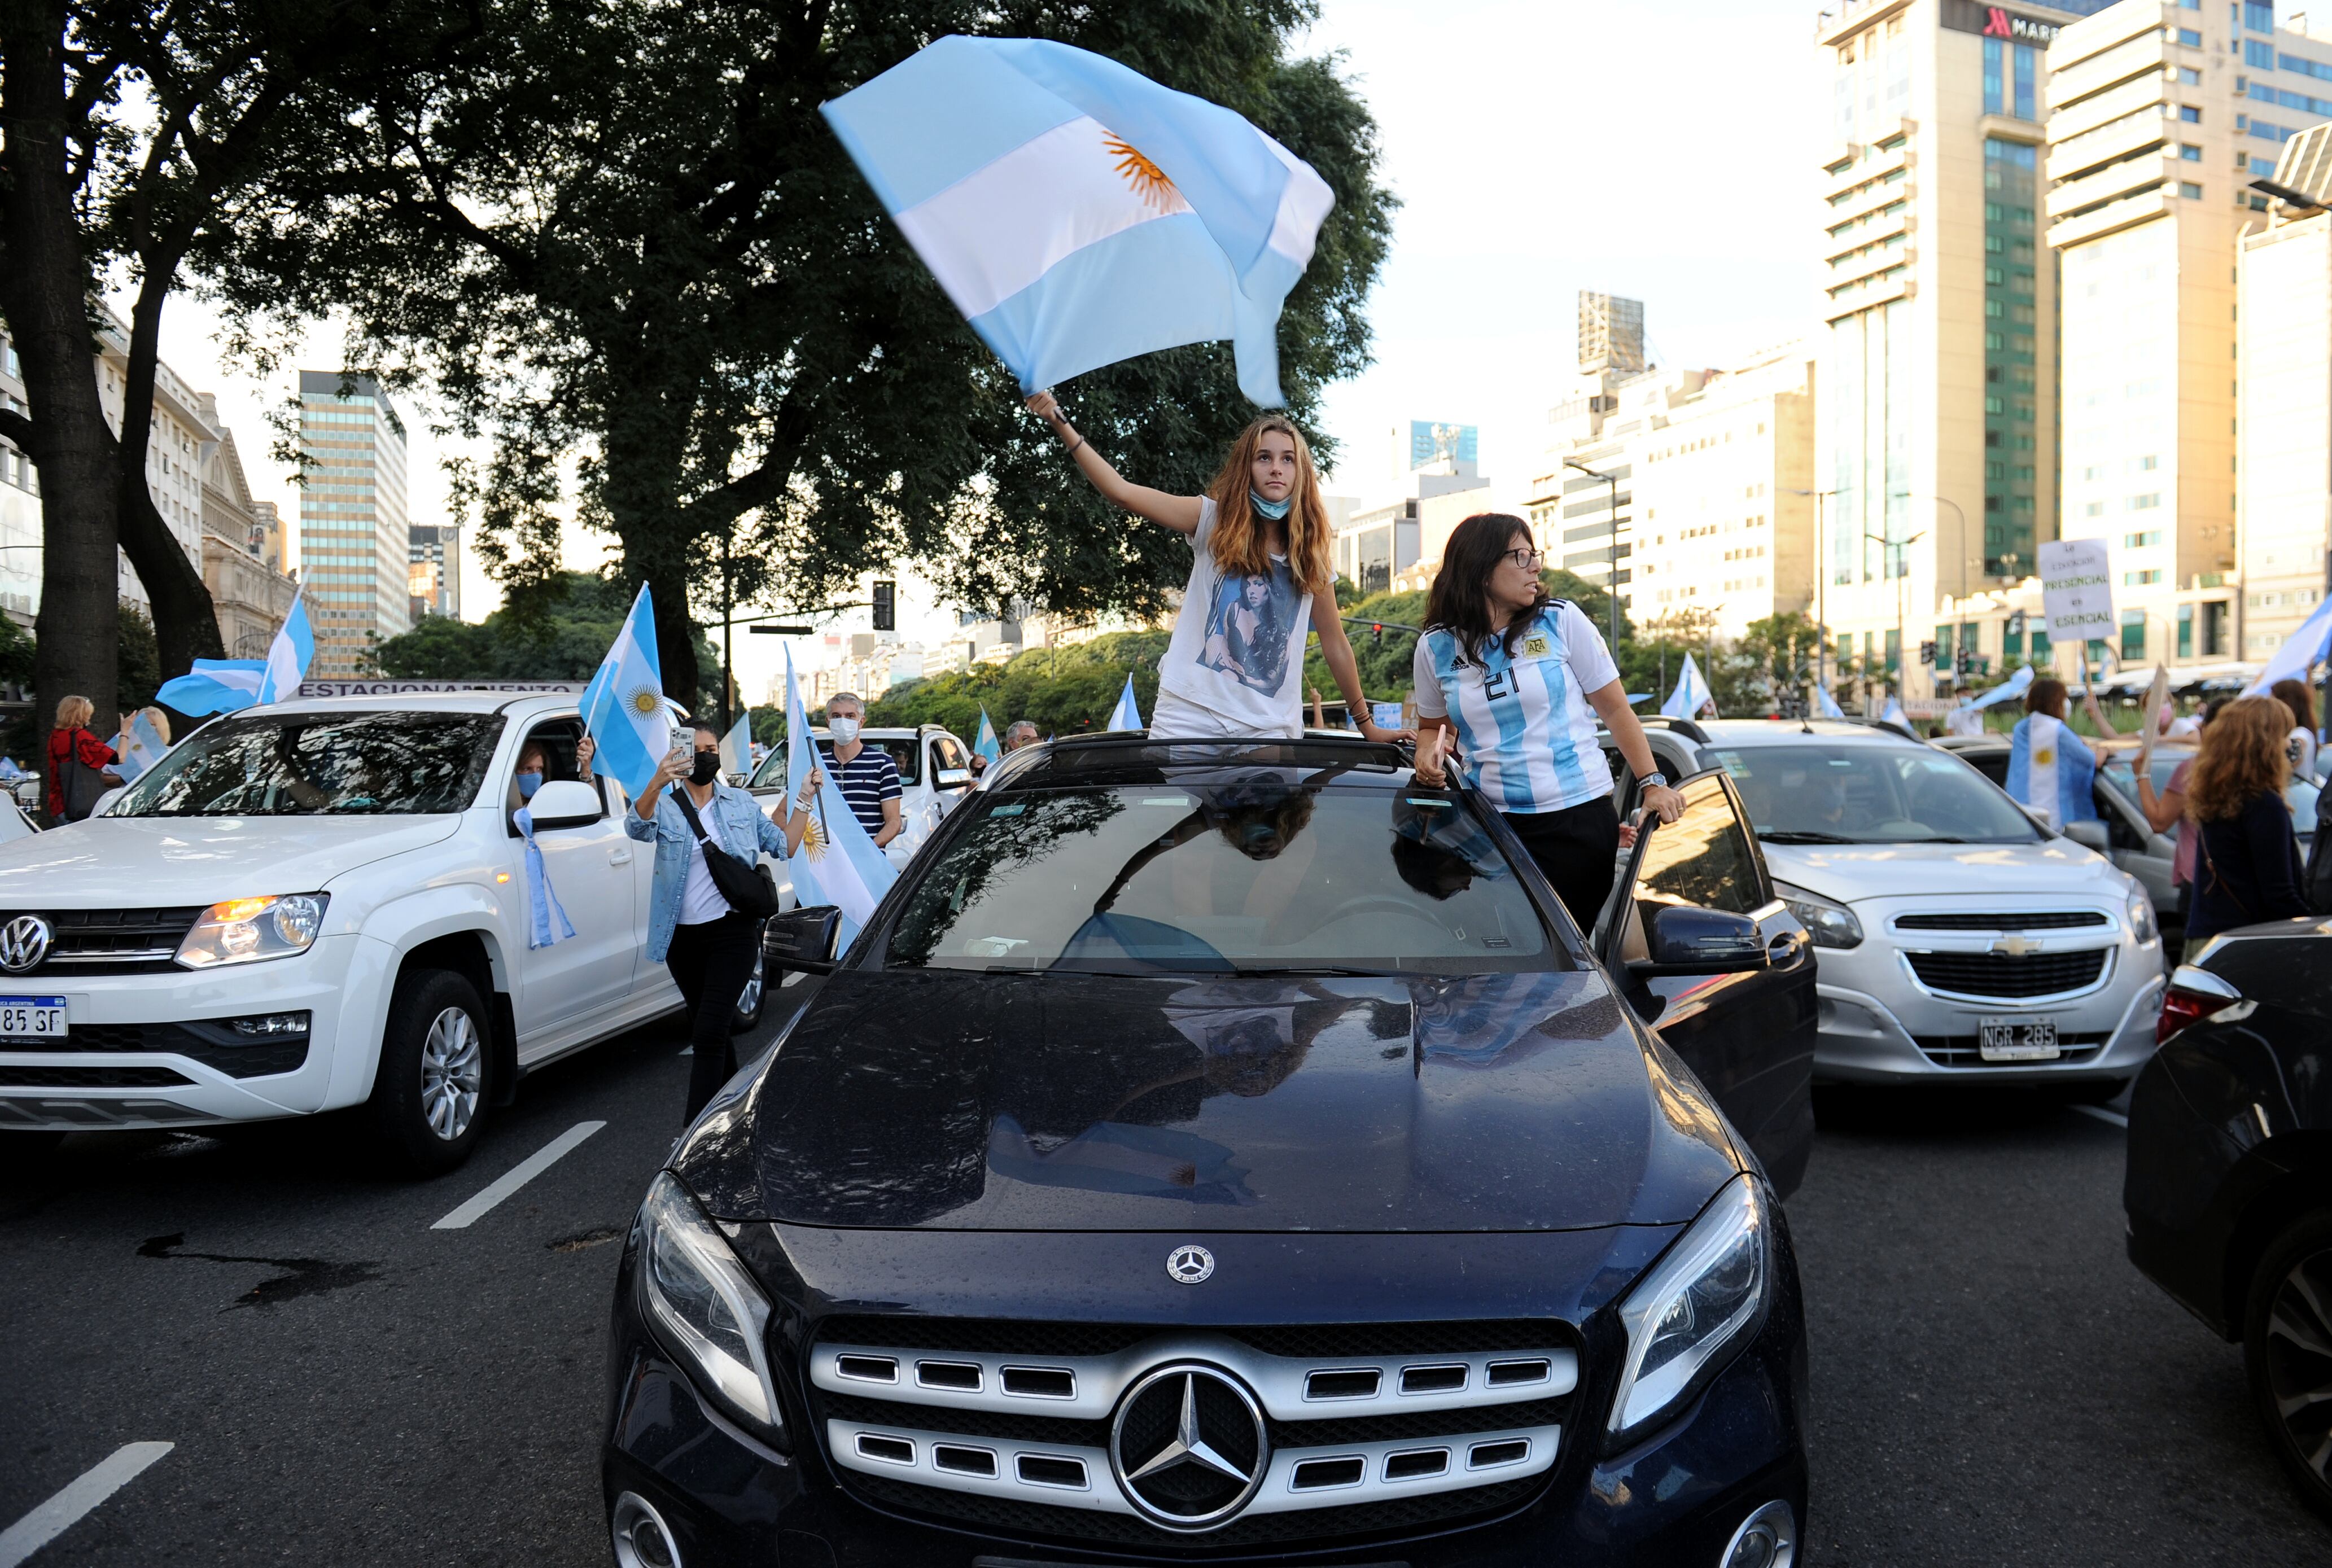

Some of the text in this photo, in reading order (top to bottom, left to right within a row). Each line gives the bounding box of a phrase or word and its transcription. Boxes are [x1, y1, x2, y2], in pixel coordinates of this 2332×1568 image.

[2045, 574, 2109, 590] PRESENCIAL
[2055, 610, 2111, 628] ESENCIAL
[1529, 638, 1546, 652] AFA
[299, 684, 570, 697] ESTACIONAIENTO
[1484, 667, 1520, 702] 21
[1984, 1026, 2054, 1047] NGR 285
